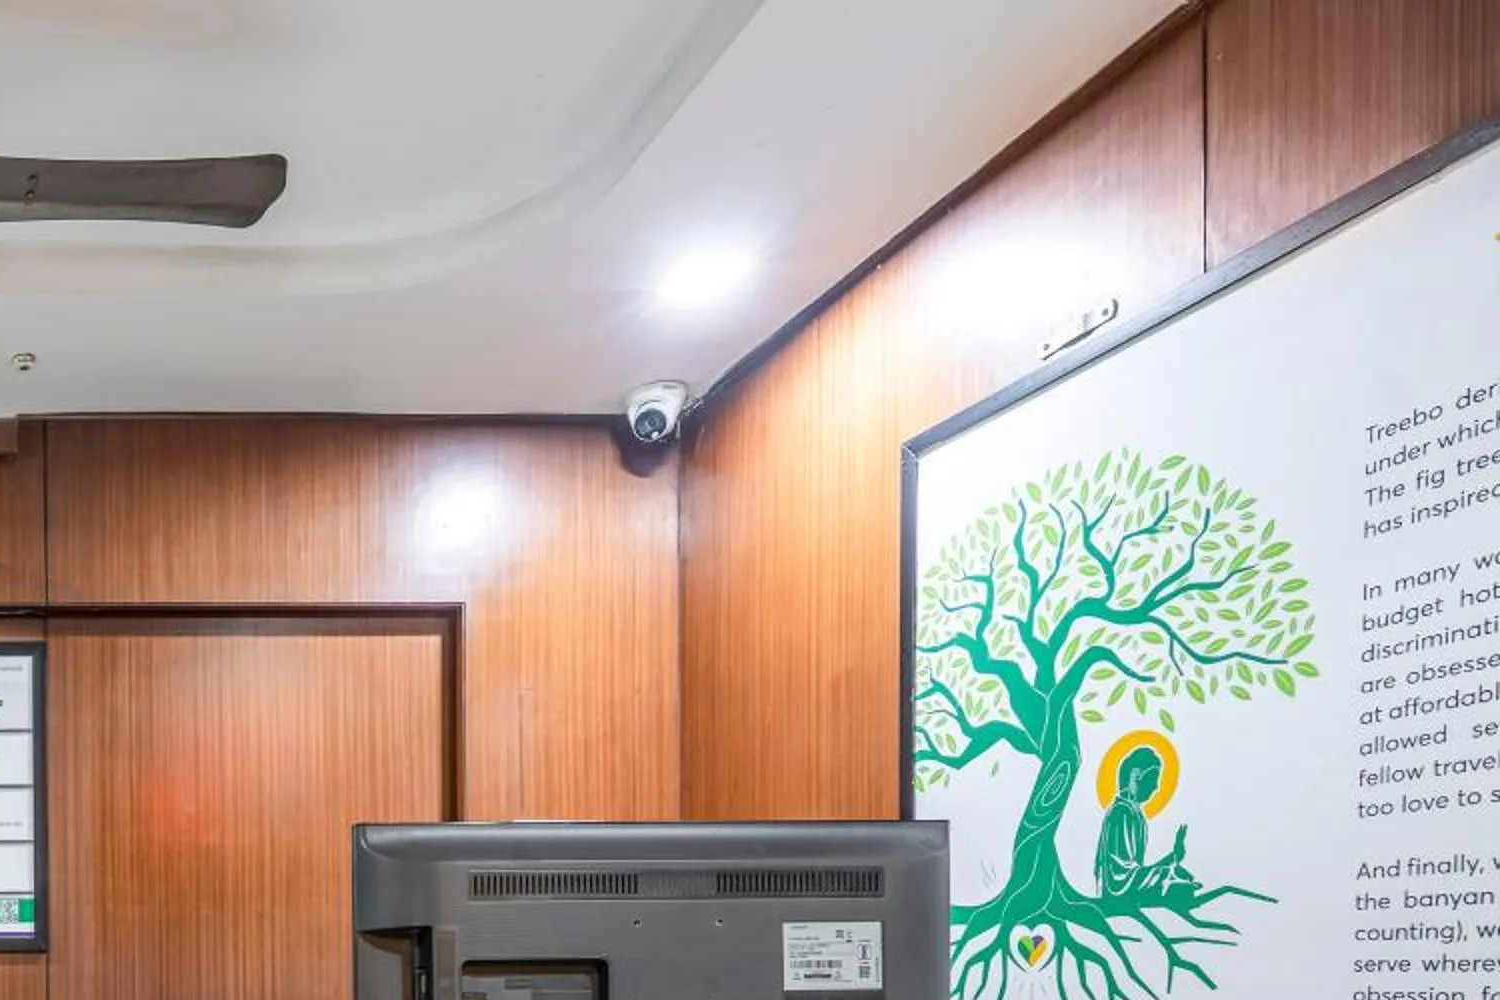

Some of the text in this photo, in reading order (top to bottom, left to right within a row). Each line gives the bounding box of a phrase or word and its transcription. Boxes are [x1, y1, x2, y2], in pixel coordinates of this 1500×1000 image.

[1366, 382, 1500, 444] Treebo der
[1365, 440, 1431, 475] under
[1364, 483, 1405, 507] The
[1417, 469, 1445, 491] fig
[1363, 514, 1403, 539] has
[1363, 583, 1382, 601] In
[1395, 563, 1460, 593] many
[1363, 604, 1444, 632] budget
[1361, 615, 1500, 663] discriminati
[1361, 653, 1500, 694] are obsesse
[1360, 681, 1500, 725] at affordabl
[1360, 723, 1447, 756] allowed
[1359, 765, 1425, 787] fellow
[1358, 802, 1395, 818] too
[1402, 793, 1450, 813] love
[1457, 789, 1482, 807] to
[1356, 859, 1401, 881] And
[1408, 853, 1485, 876] finally,
[1355, 889, 1495, 911] the banyan
[1354, 919, 1500, 944] counting), w
[1353, 953, 1500, 973] serve where
